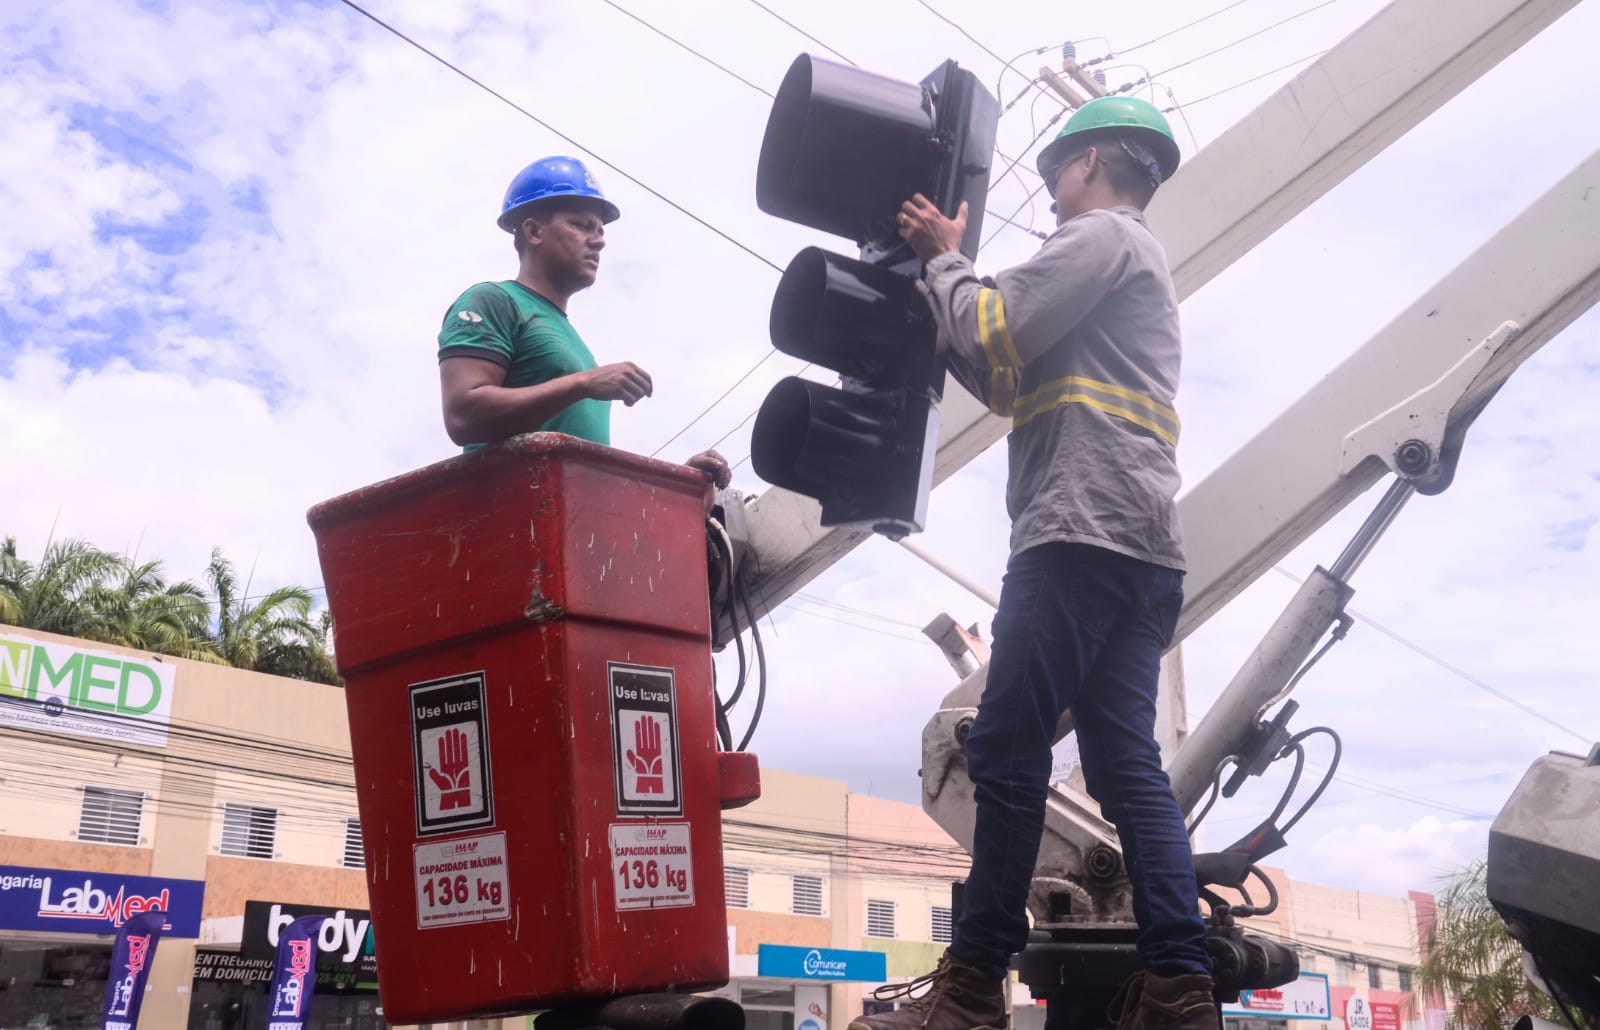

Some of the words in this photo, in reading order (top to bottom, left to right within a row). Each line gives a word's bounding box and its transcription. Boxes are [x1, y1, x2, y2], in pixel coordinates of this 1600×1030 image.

[613, 685, 638, 700] Use
[417, 706, 441, 719] Use
[444, 699, 479, 714] luvas
[615, 846, 658, 857] CAPACIDADE
[659, 844, 687, 855] MÁXIMA
[419, 861, 469, 875] CAPACIDADE
[470, 855, 503, 869] MÁXIMA
[619, 859, 659, 889] 136
[665, 864, 687, 892] kg
[423, 874, 469, 907] 136
[476, 877, 503, 905] kg
[39, 876, 169, 927] LabMed
[196, 953, 276, 969] ENTREGAMO
[114, 934, 150, 1017] LabMed
[193, 967, 214, 979] EM
[215, 967, 274, 981] DOMICÍLI
[279, 937, 311, 1018] LabMed
